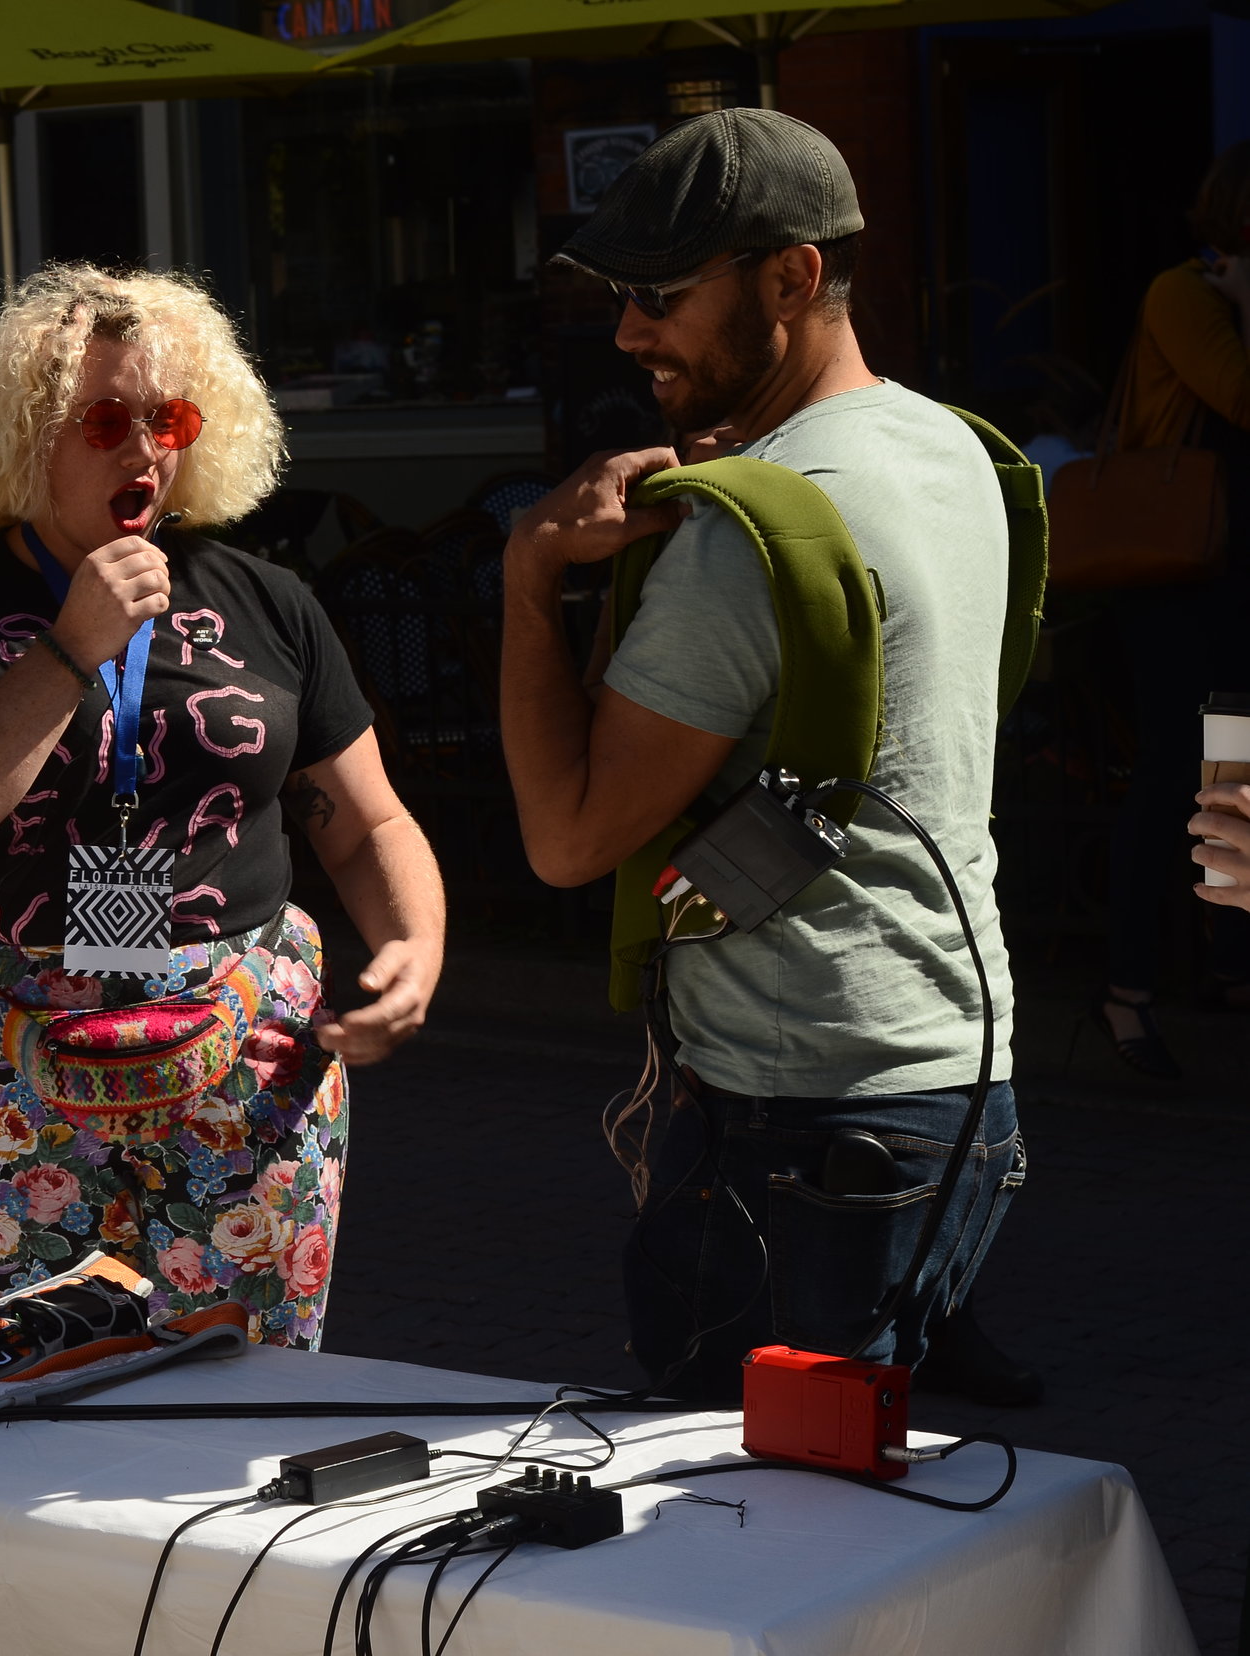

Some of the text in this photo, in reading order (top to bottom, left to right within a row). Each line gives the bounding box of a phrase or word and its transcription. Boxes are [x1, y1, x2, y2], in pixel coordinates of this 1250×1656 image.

[277, 0, 394, 40] CANADIAN
[69, 869, 171, 886] FLOTTILLE
[78, 882, 115, 891] LAISSEZ
[130, 885, 162, 893] PASSER
